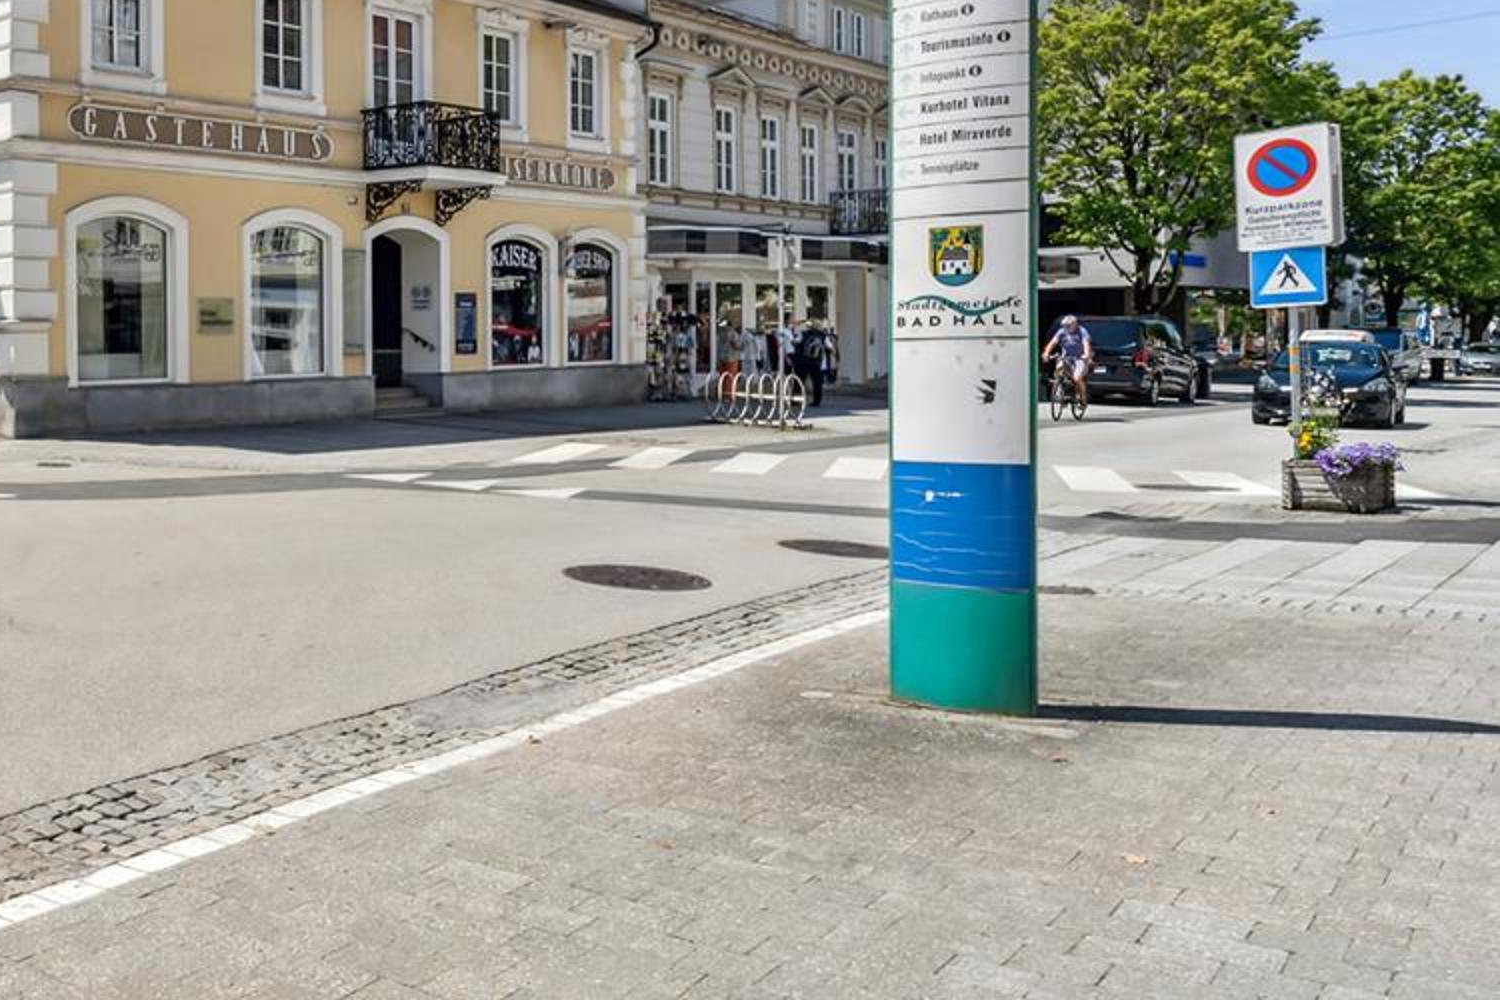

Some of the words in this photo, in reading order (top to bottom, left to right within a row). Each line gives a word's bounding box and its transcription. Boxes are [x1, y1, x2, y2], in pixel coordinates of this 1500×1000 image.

[920, 7, 959, 22] Rathaus
[920, 32, 994, 53] Tourismusinfo
[920, 67, 966, 83] Infopunkt
[920, 97, 968, 114] Kurhotel
[972, 95, 1010, 108] Vitana
[920, 131, 948, 144] Hotel
[952, 125, 1012, 142] Miraverde
[504, 157, 606, 189] ISERKRONE
[920, 161, 980, 175] Tennisplätze
[1245, 200, 1323, 214] Kurzparkzone
[492, 244, 538, 271] KAISER
[897, 316, 941, 328] BAD
[953, 313, 1022, 326] HALL
